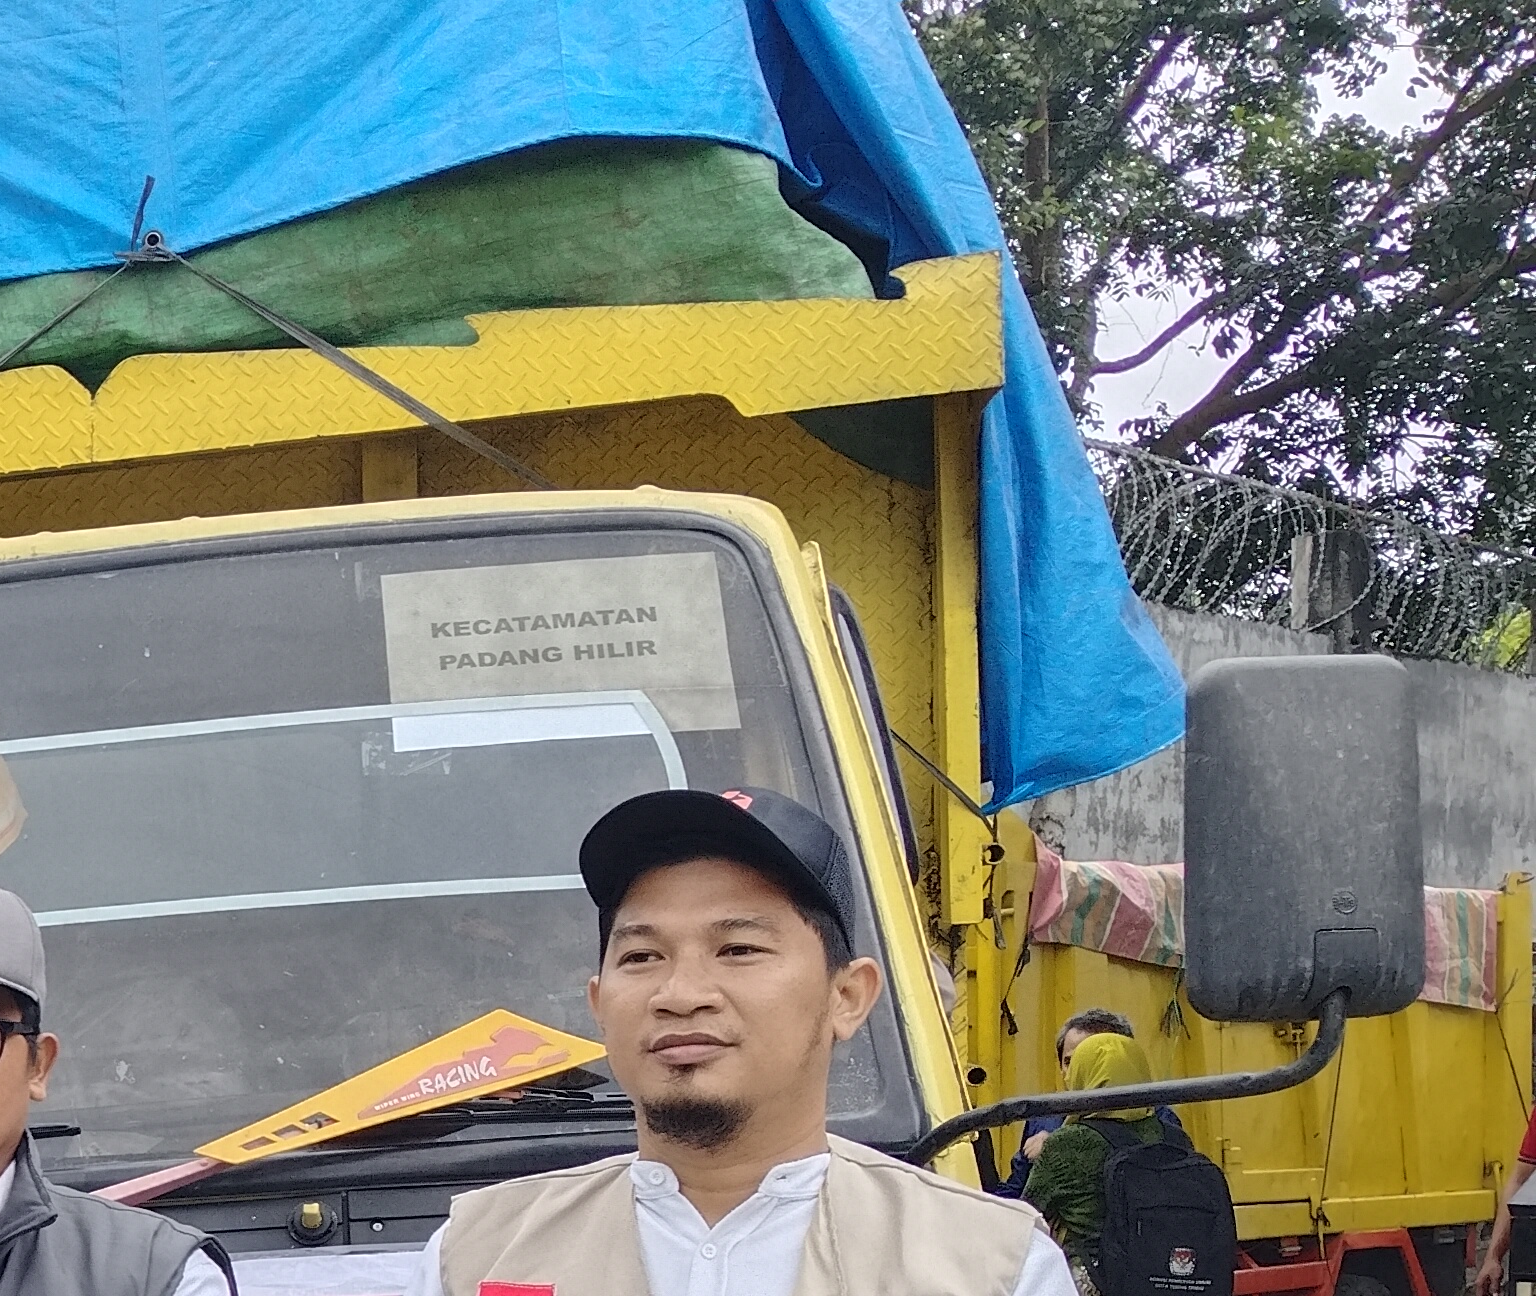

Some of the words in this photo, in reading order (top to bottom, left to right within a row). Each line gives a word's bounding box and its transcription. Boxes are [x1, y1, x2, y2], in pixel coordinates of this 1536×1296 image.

[430, 606, 658, 639] KECATAMATAN
[438, 646, 564, 671] PADANG
[574, 639, 658, 662] HILIR
[417, 1056, 498, 1095] RACING
